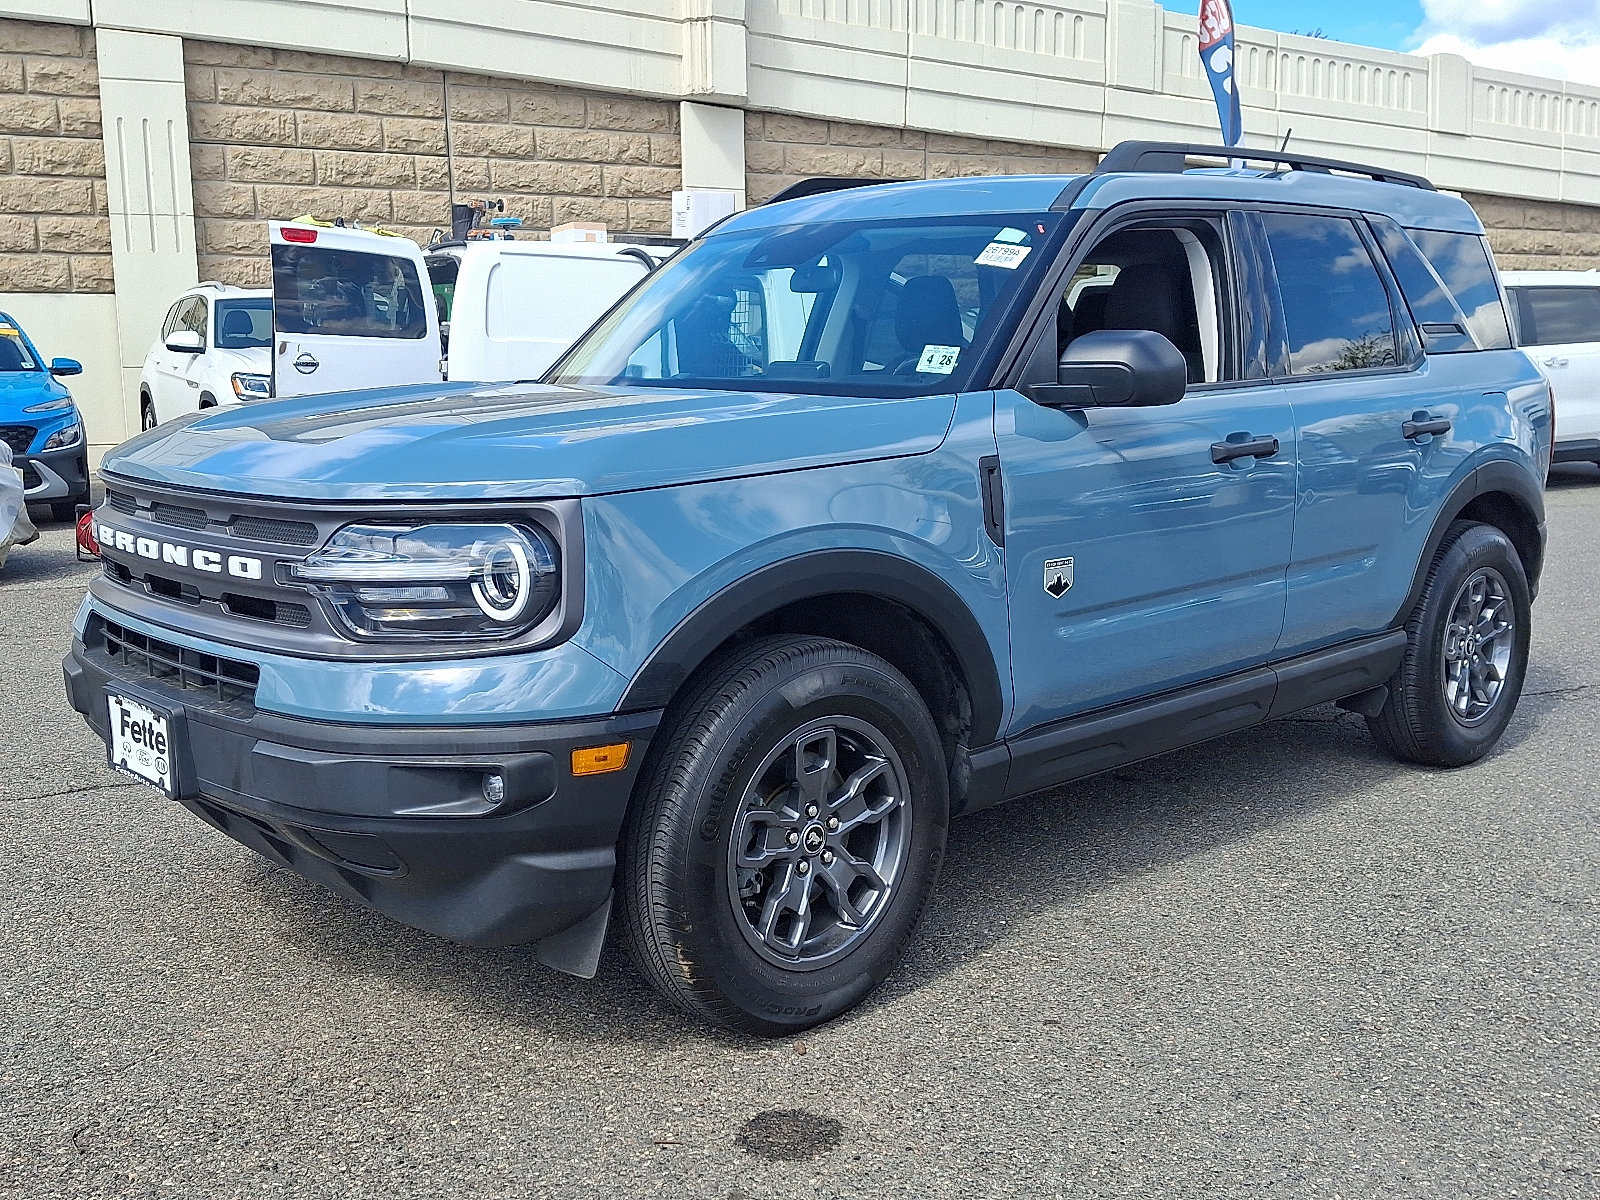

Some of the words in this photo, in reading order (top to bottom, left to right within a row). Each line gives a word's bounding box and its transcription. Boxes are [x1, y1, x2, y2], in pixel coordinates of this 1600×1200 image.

[926, 354, 934, 364] 4
[939, 354, 954, 365] 28
[99, 524, 262, 580] BRONCO
[120, 707, 167, 755] Fette
[115, 765, 166, 796] FetteAuto.com
